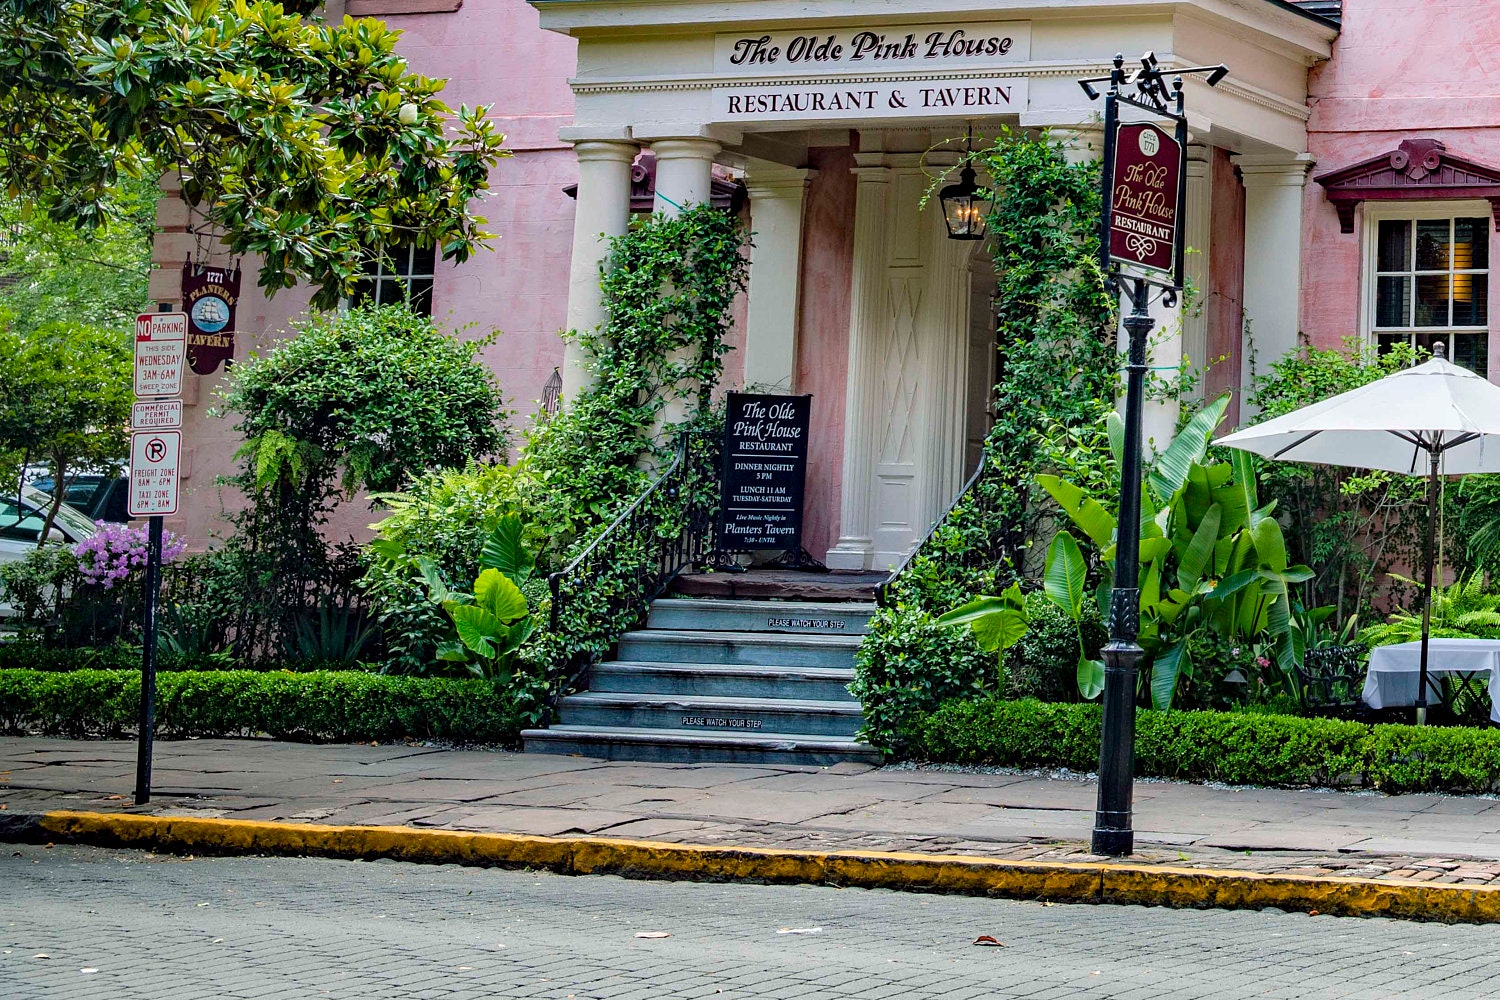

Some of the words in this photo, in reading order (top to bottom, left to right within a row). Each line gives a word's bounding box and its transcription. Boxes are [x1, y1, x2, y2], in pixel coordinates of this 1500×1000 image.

[730, 35, 781, 65] The
[786, 34, 843, 63] Olde
[849, 31, 918, 62] Pink
[924, 29, 1013, 60] House
[727, 91, 879, 114] RESTAURANT
[888, 89, 908, 108] &
[919, 86, 1012, 108] TAVERN
[1144, 140, 1155, 153] 1771
[1124, 164, 1144, 183] The
[1144, 160, 1168, 189] Olde
[1114, 184, 1143, 210] Pink
[1136, 190, 1174, 219] House
[1115, 214, 1171, 240] RESTAURANT
[206, 271, 224, 284] 1771
[189, 284, 235, 306] PLANTERS
[137, 320, 151, 336] NO
[152, 322, 184, 334] PARKING
[187, 333, 230, 347] TAVERN
[139, 354, 181, 366] WEDNESDAY
[161, 382, 178, 390] ZONE
[135, 404, 179, 412] COMMERCIAL
[742, 401, 766, 419] The
[768, 402, 795, 420] Olde
[140, 417, 174, 425] REQUIRED
[732, 420, 767, 442] Pink
[764, 420, 801, 439] House
[739, 441, 794, 451] RESTAURANT
[734, 462, 763, 470] DINNER
[763, 463, 795, 471] NIGHTLY
[134, 469, 157, 478] FREIGHT
[160, 468, 175, 477] ZONE
[756, 472, 761, 480] 5
[761, 472, 773, 480] PM
[138, 478, 150, 487] 8AM
[159, 478, 171, 486] 6PM
[139, 491, 152, 499] TAXI
[154, 490, 169, 498] ZONE
[740, 486, 765, 494] LUNCH
[766, 486, 774, 494] 11
[774, 486, 786, 494] AM
[137, 500, 149, 509] 6PM
[157, 500, 170, 508] 8AM
[732, 495, 793, 503] TUESDAY-SATURDAY
[724, 522, 763, 534] Planters
[764, 523, 795, 535] Tavern
[768, 618, 790, 627] PLEASE
[791, 619, 811, 628] WATCH
[813, 619, 828, 628] YOUR
[829, 620, 845, 629] STEP
[682, 717, 704, 726] PLEASE
[706, 718, 727, 727] WATCH
[728, 719, 745, 728] YOUR
[746, 719, 762, 728] STEP
